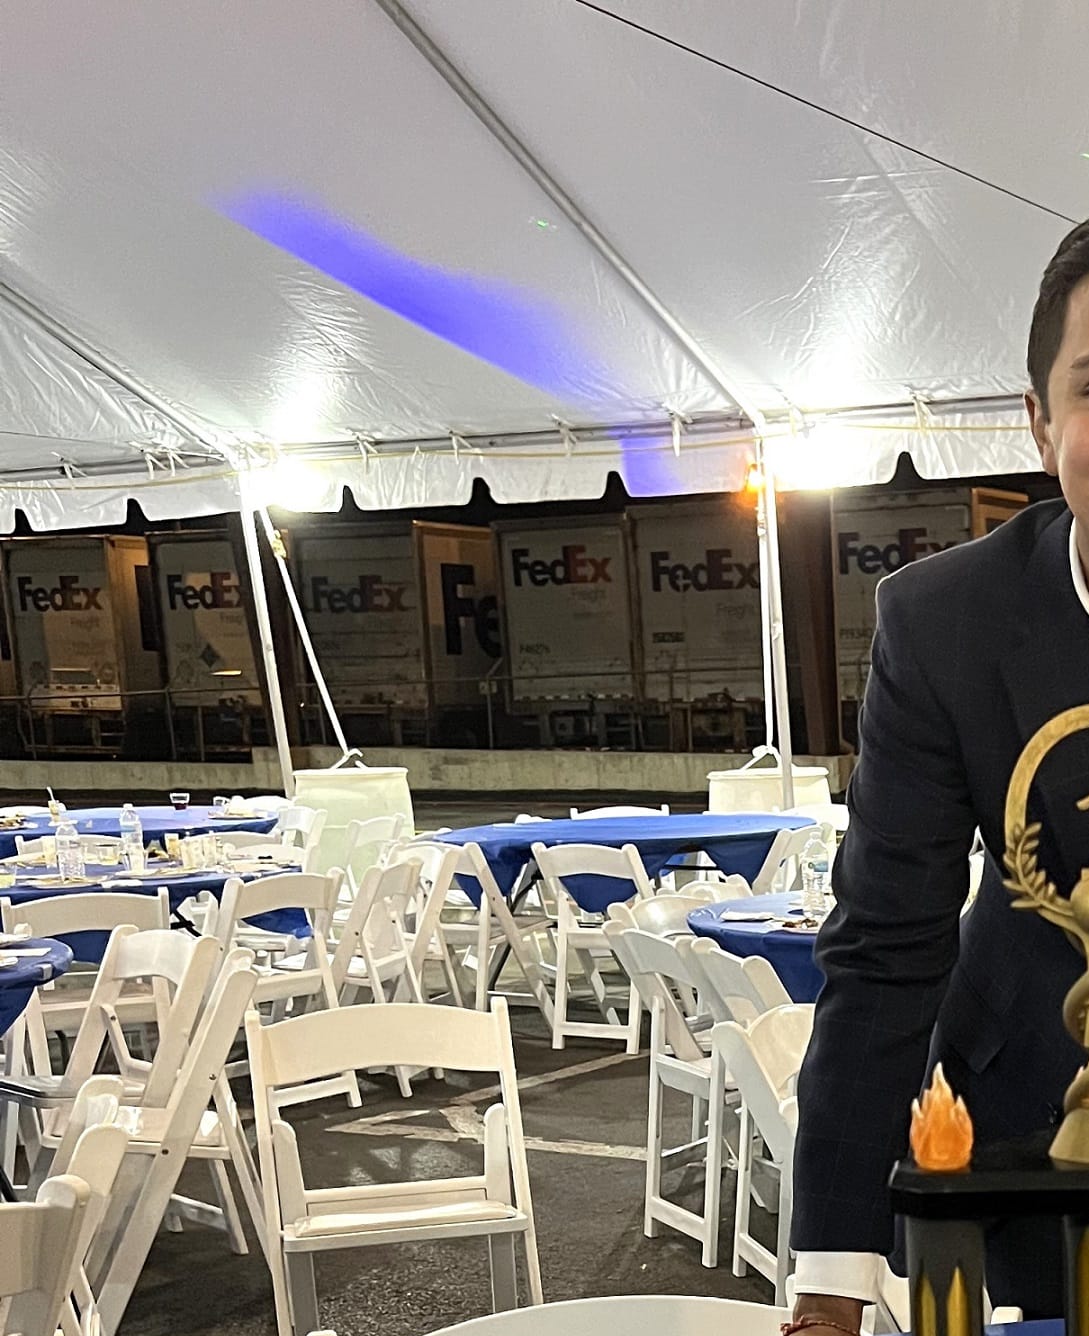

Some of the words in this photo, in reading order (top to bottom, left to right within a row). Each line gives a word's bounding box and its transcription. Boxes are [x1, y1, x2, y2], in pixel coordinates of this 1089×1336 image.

[511, 545, 612, 587] FedEx
[650, 549, 760, 592] FedEx
[838, 528, 958, 575] FedE
[17, 575, 103, 612] FedEx
[311, 575, 406, 613] FedEx
